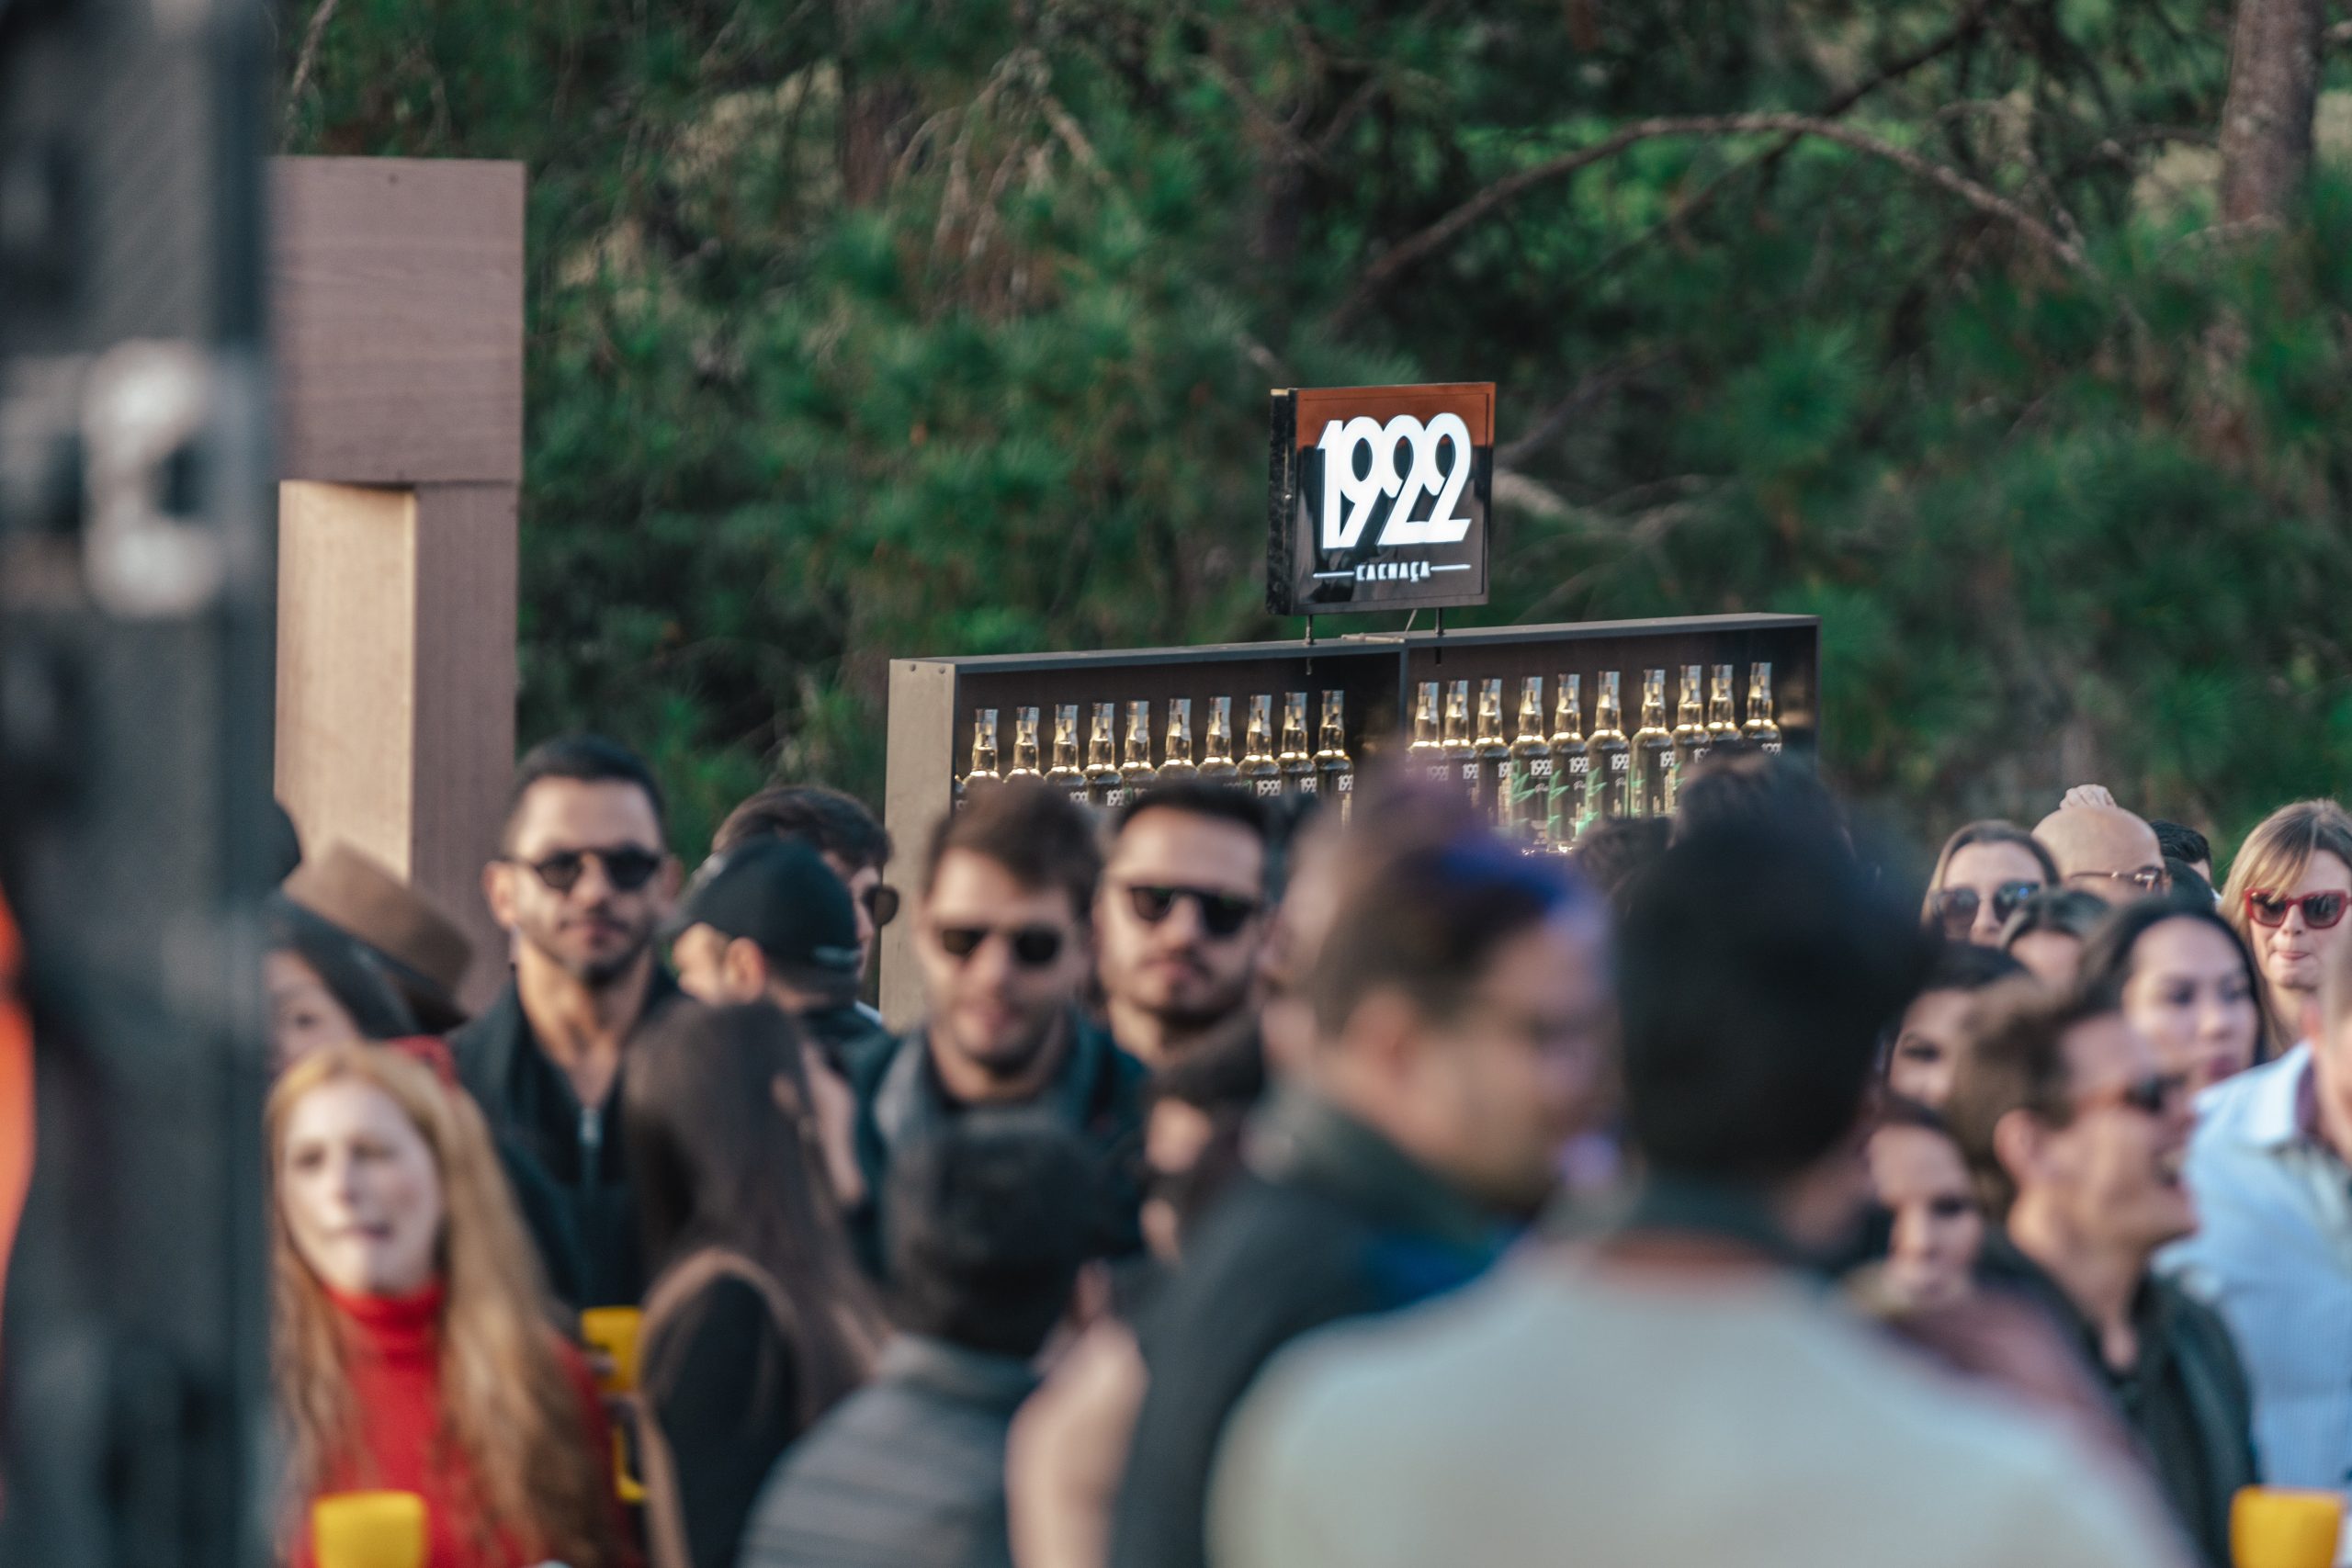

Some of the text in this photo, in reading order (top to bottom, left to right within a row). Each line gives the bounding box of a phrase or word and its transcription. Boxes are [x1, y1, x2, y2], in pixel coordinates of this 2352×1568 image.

[1316, 412, 1472, 549] 1922
[1356, 561, 1430, 582] CACHAÇA
[1568, 757, 1589, 773] 192
